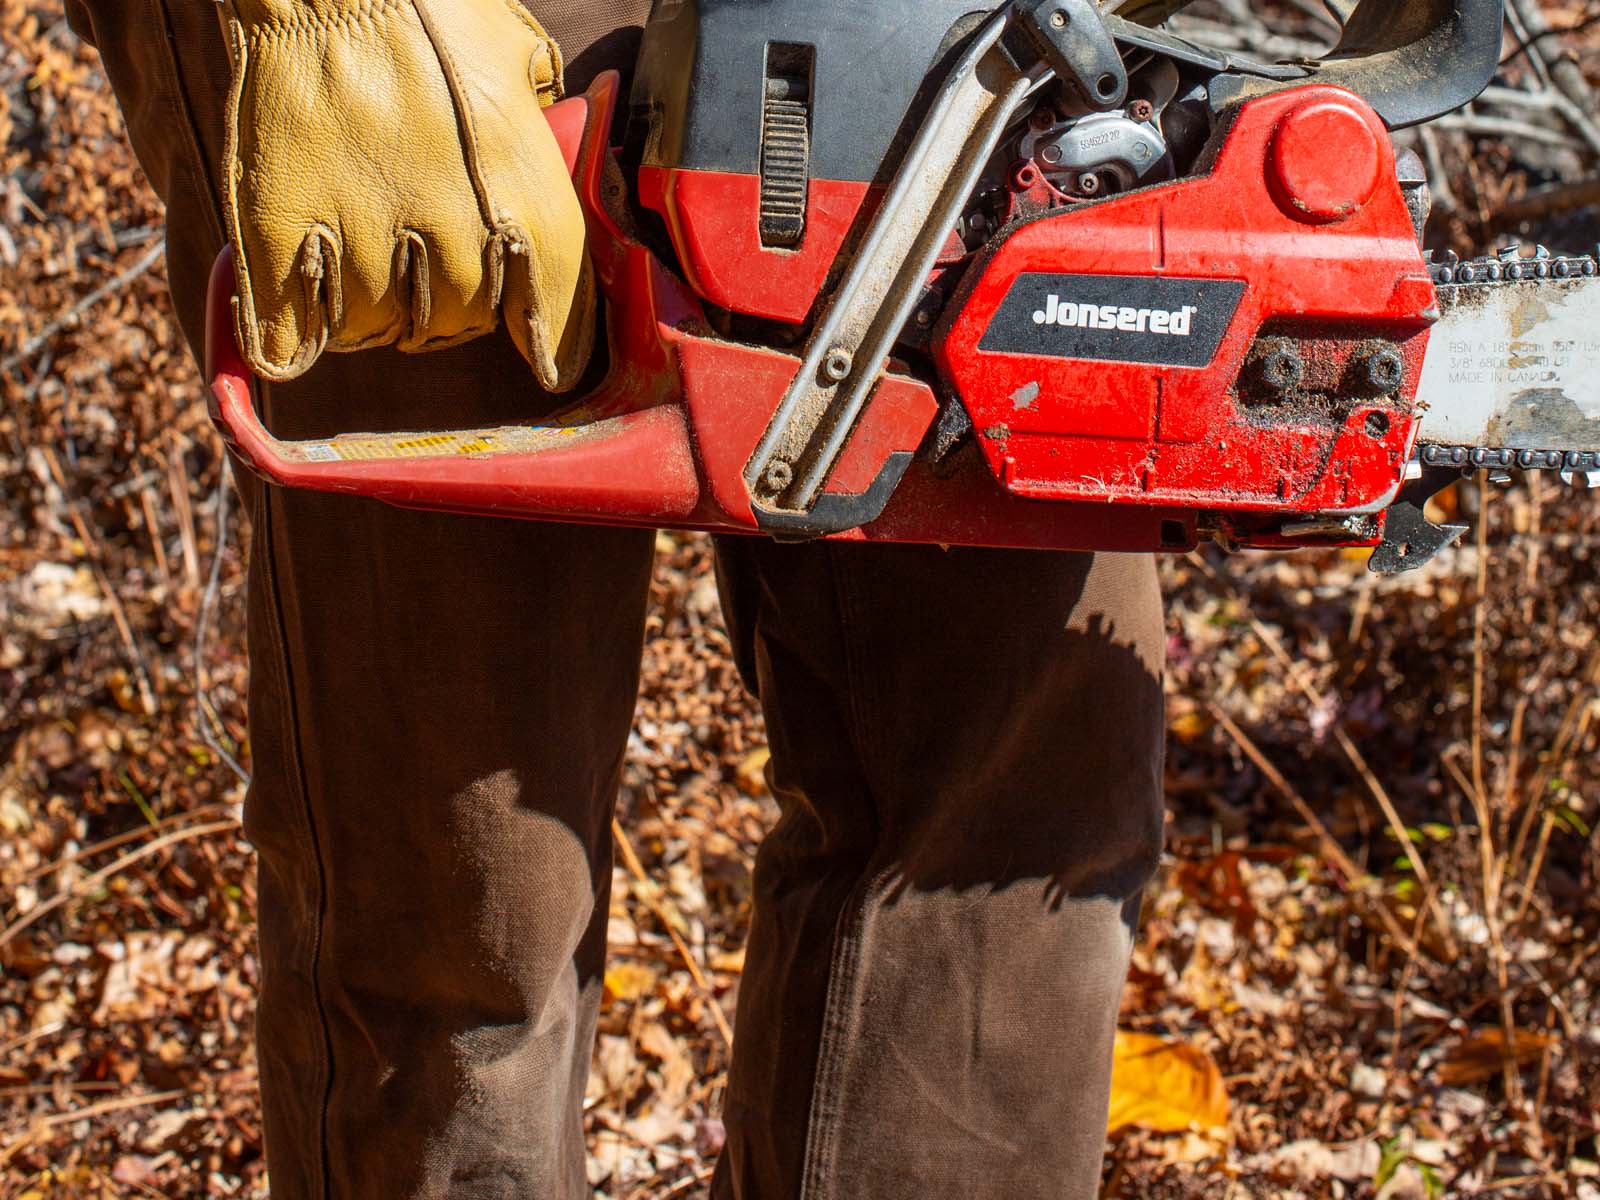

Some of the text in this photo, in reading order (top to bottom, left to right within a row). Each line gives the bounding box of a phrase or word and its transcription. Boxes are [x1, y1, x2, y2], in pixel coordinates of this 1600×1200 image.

[1032, 294, 1192, 336] Jonsered
[1448, 370, 1561, 383] MADE IN CANADA
